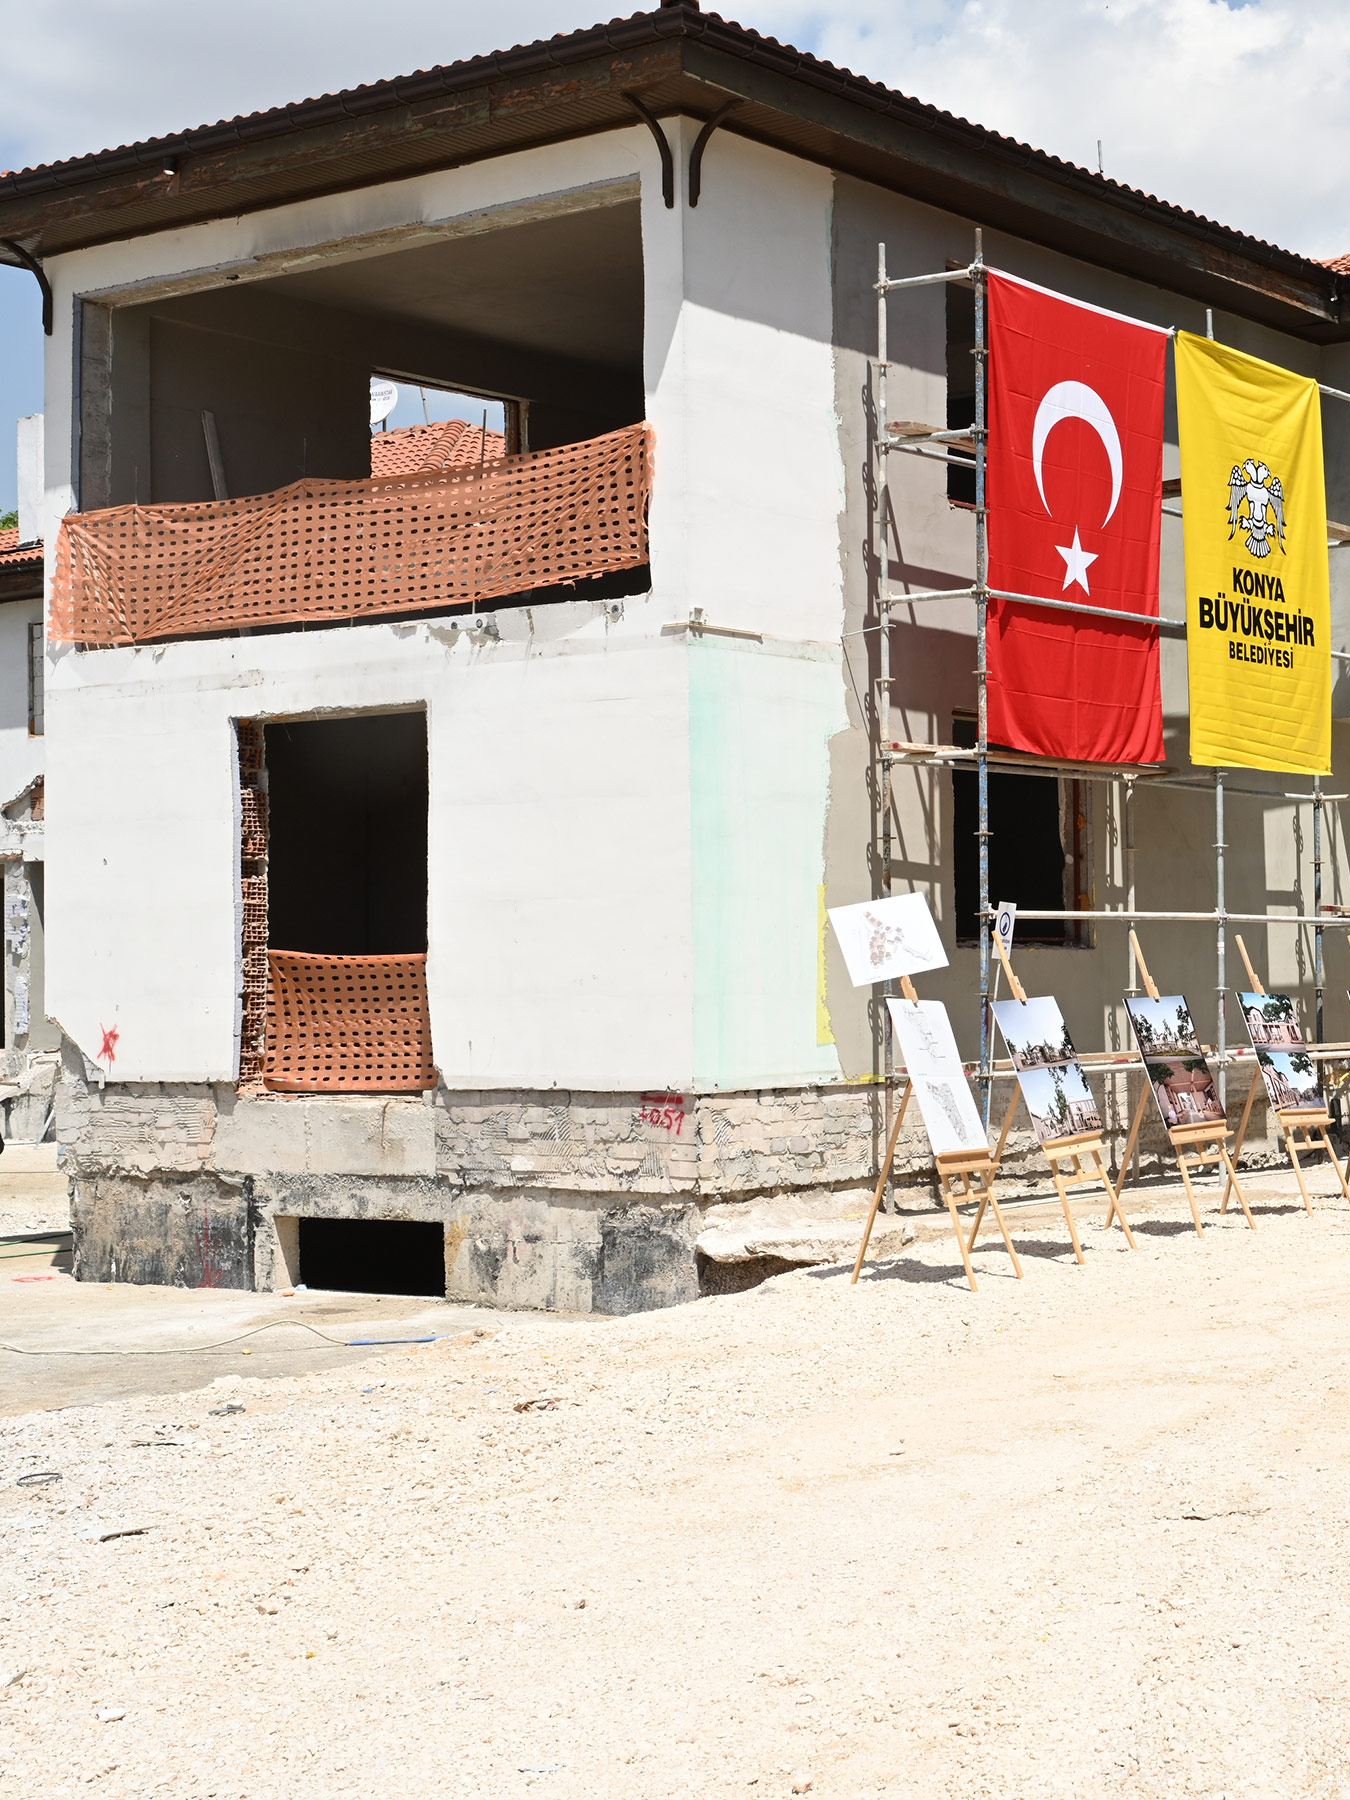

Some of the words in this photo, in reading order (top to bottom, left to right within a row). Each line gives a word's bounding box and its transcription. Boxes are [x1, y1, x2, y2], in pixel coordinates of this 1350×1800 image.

[1233, 567, 1285, 603] KONYA
[1199, 592, 1315, 647] BÜYÜKŞEHİR
[1229, 640, 1294, 669] BELEDİYESİ
